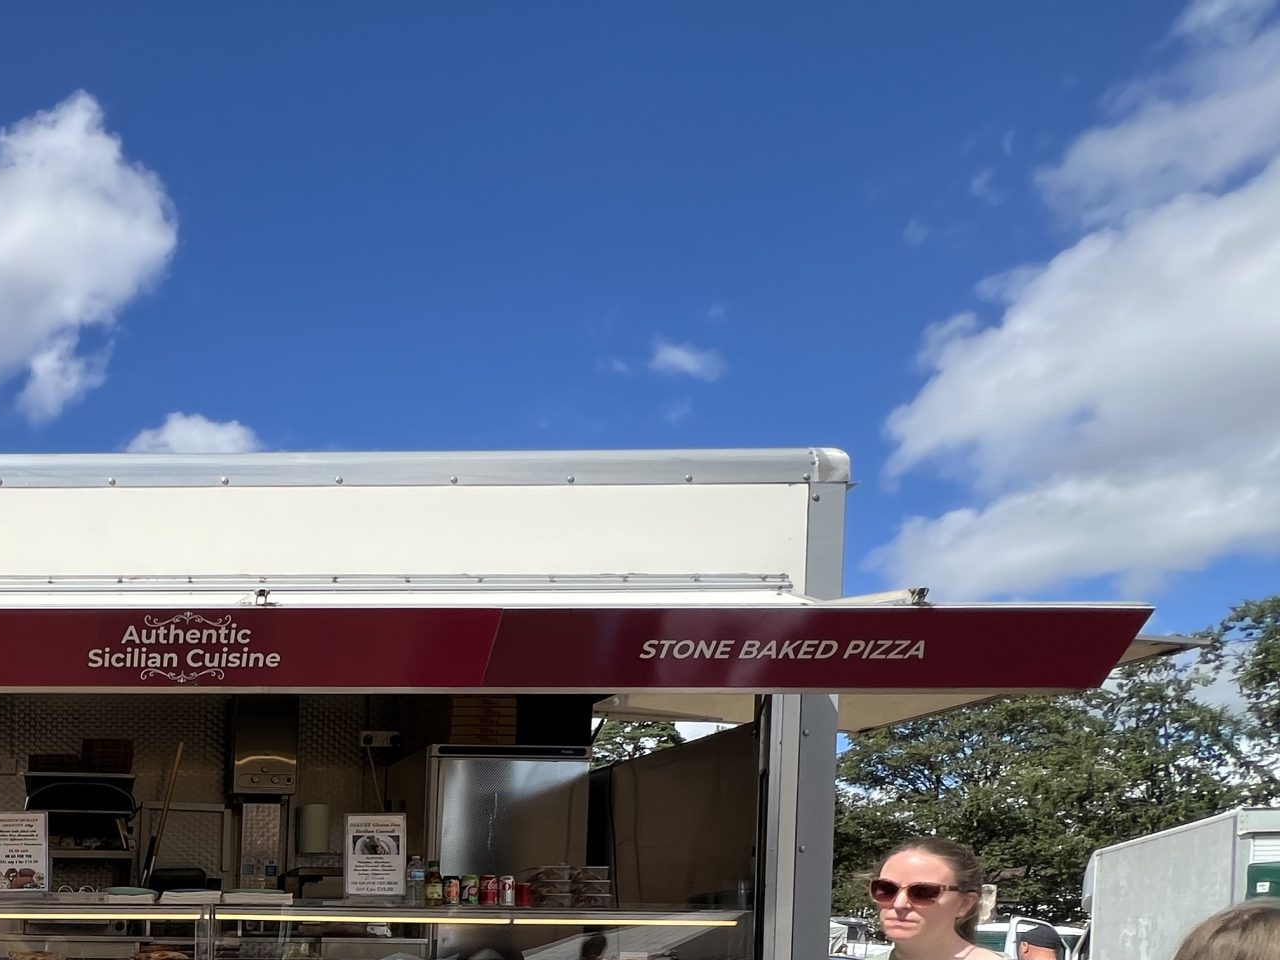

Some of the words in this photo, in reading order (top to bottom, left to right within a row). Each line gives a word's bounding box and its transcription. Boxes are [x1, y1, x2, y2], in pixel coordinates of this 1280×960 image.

[120, 623, 251, 644] Authentic
[88, 647, 178, 668] Sicilian
[186, 647, 281, 668] Cuisine
[639, 639, 736, 659] STONE
[738, 639, 838, 659] BAKED
[843, 639, 925, 659] PIZZA
